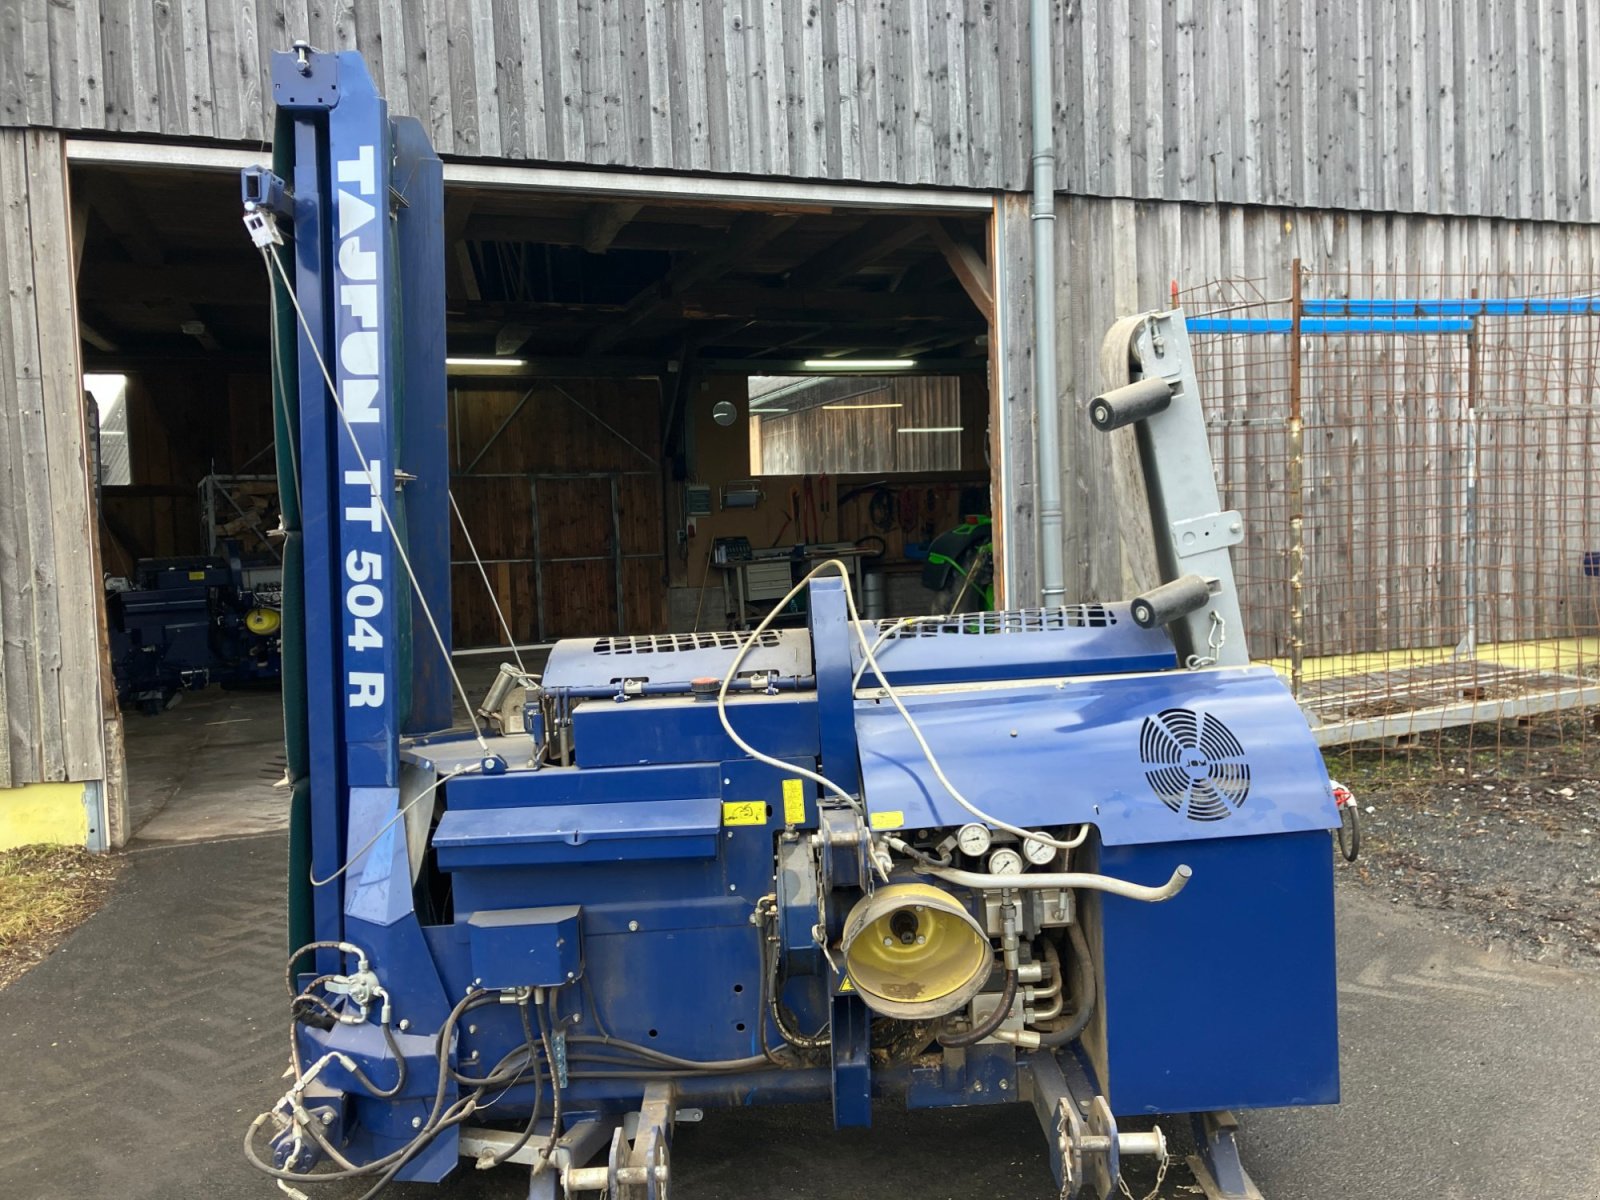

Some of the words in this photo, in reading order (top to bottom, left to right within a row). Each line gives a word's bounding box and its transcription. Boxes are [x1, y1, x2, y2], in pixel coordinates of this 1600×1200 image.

[336, 144, 382, 424] TAJFUN
[344, 461, 382, 533] TT
[346, 549, 384, 652] 504
[348, 671, 385, 708] R
